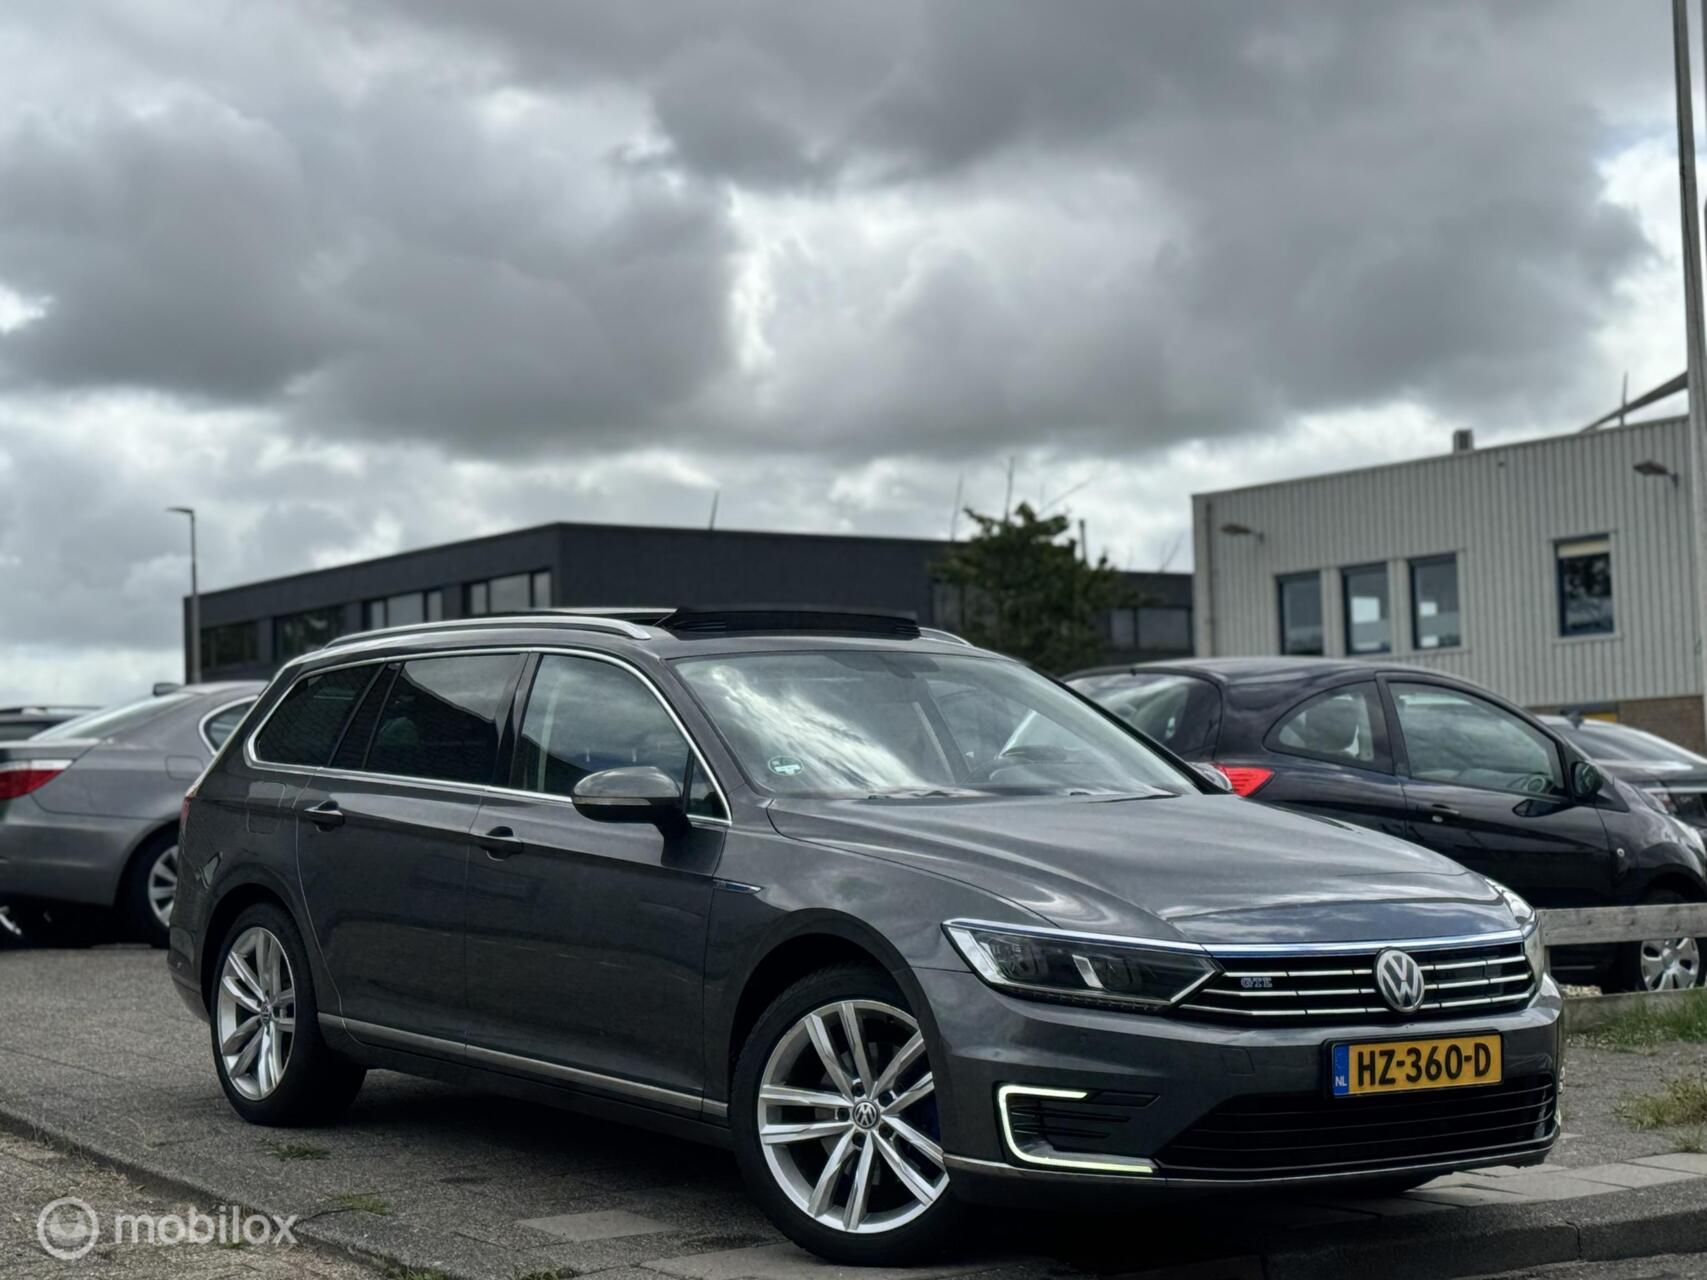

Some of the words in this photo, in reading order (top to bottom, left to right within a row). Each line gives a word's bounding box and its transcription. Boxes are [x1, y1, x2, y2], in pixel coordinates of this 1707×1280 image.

[1240, 977, 1273, 988] GTE
[1375, 949, 1425, 1013] VW
[1357, 1042, 1491, 1087] HZ-360-D
[1335, 1076, 1347, 1087] NL
